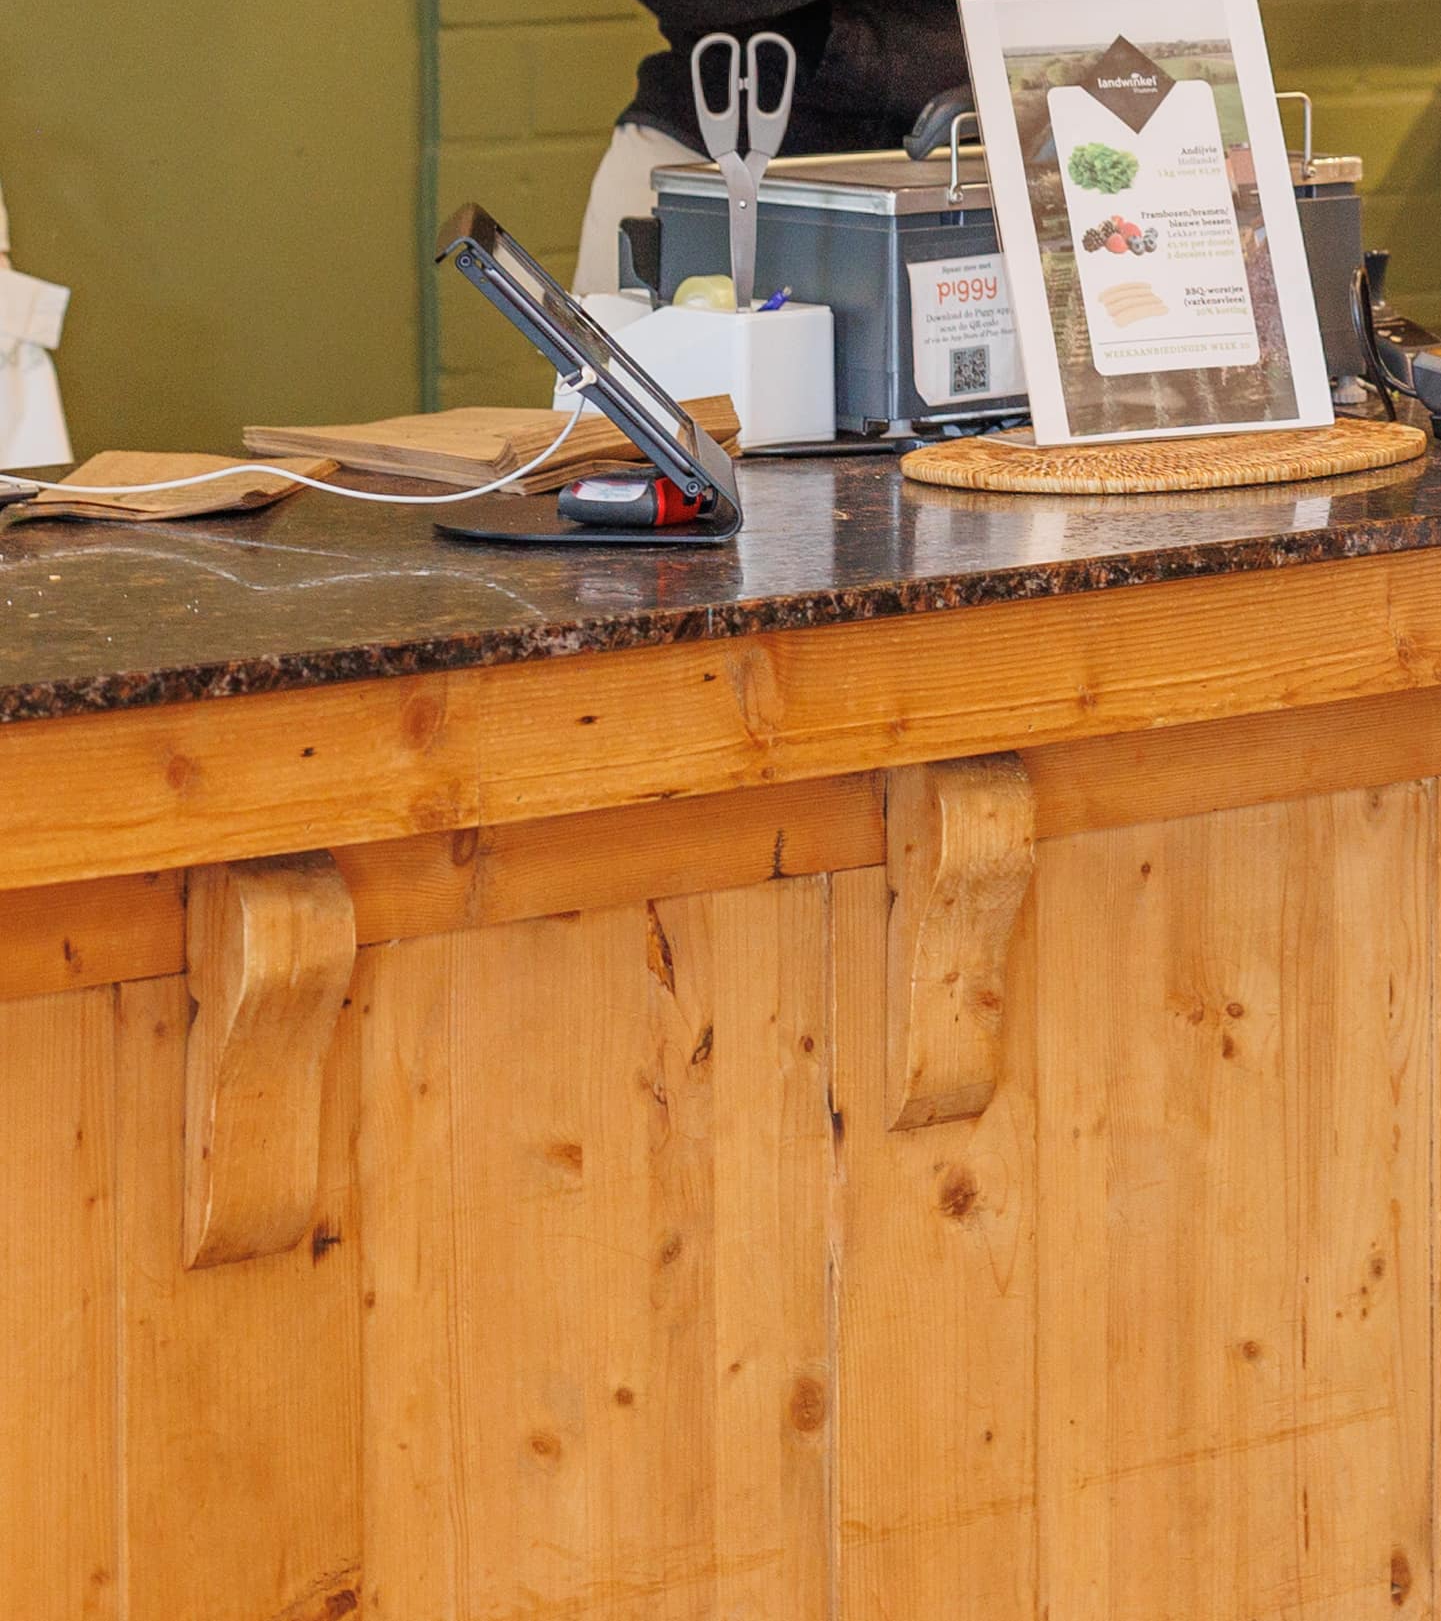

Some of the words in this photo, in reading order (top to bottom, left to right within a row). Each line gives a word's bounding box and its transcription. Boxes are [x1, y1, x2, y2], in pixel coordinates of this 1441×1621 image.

[1097, 72, 1158, 89] landwinkel
[1180, 146, 1217, 157] Andijvie
[1202, 217, 1232, 226] bessen
[936, 276, 998, 305] piggy
[926, 310, 962, 323] Download
[974, 307, 994, 318] Piggy
[1103, 343, 1208, 359] WEEKAANBIEDINGEN
[1210, 342, 1237, 351] WEEK
